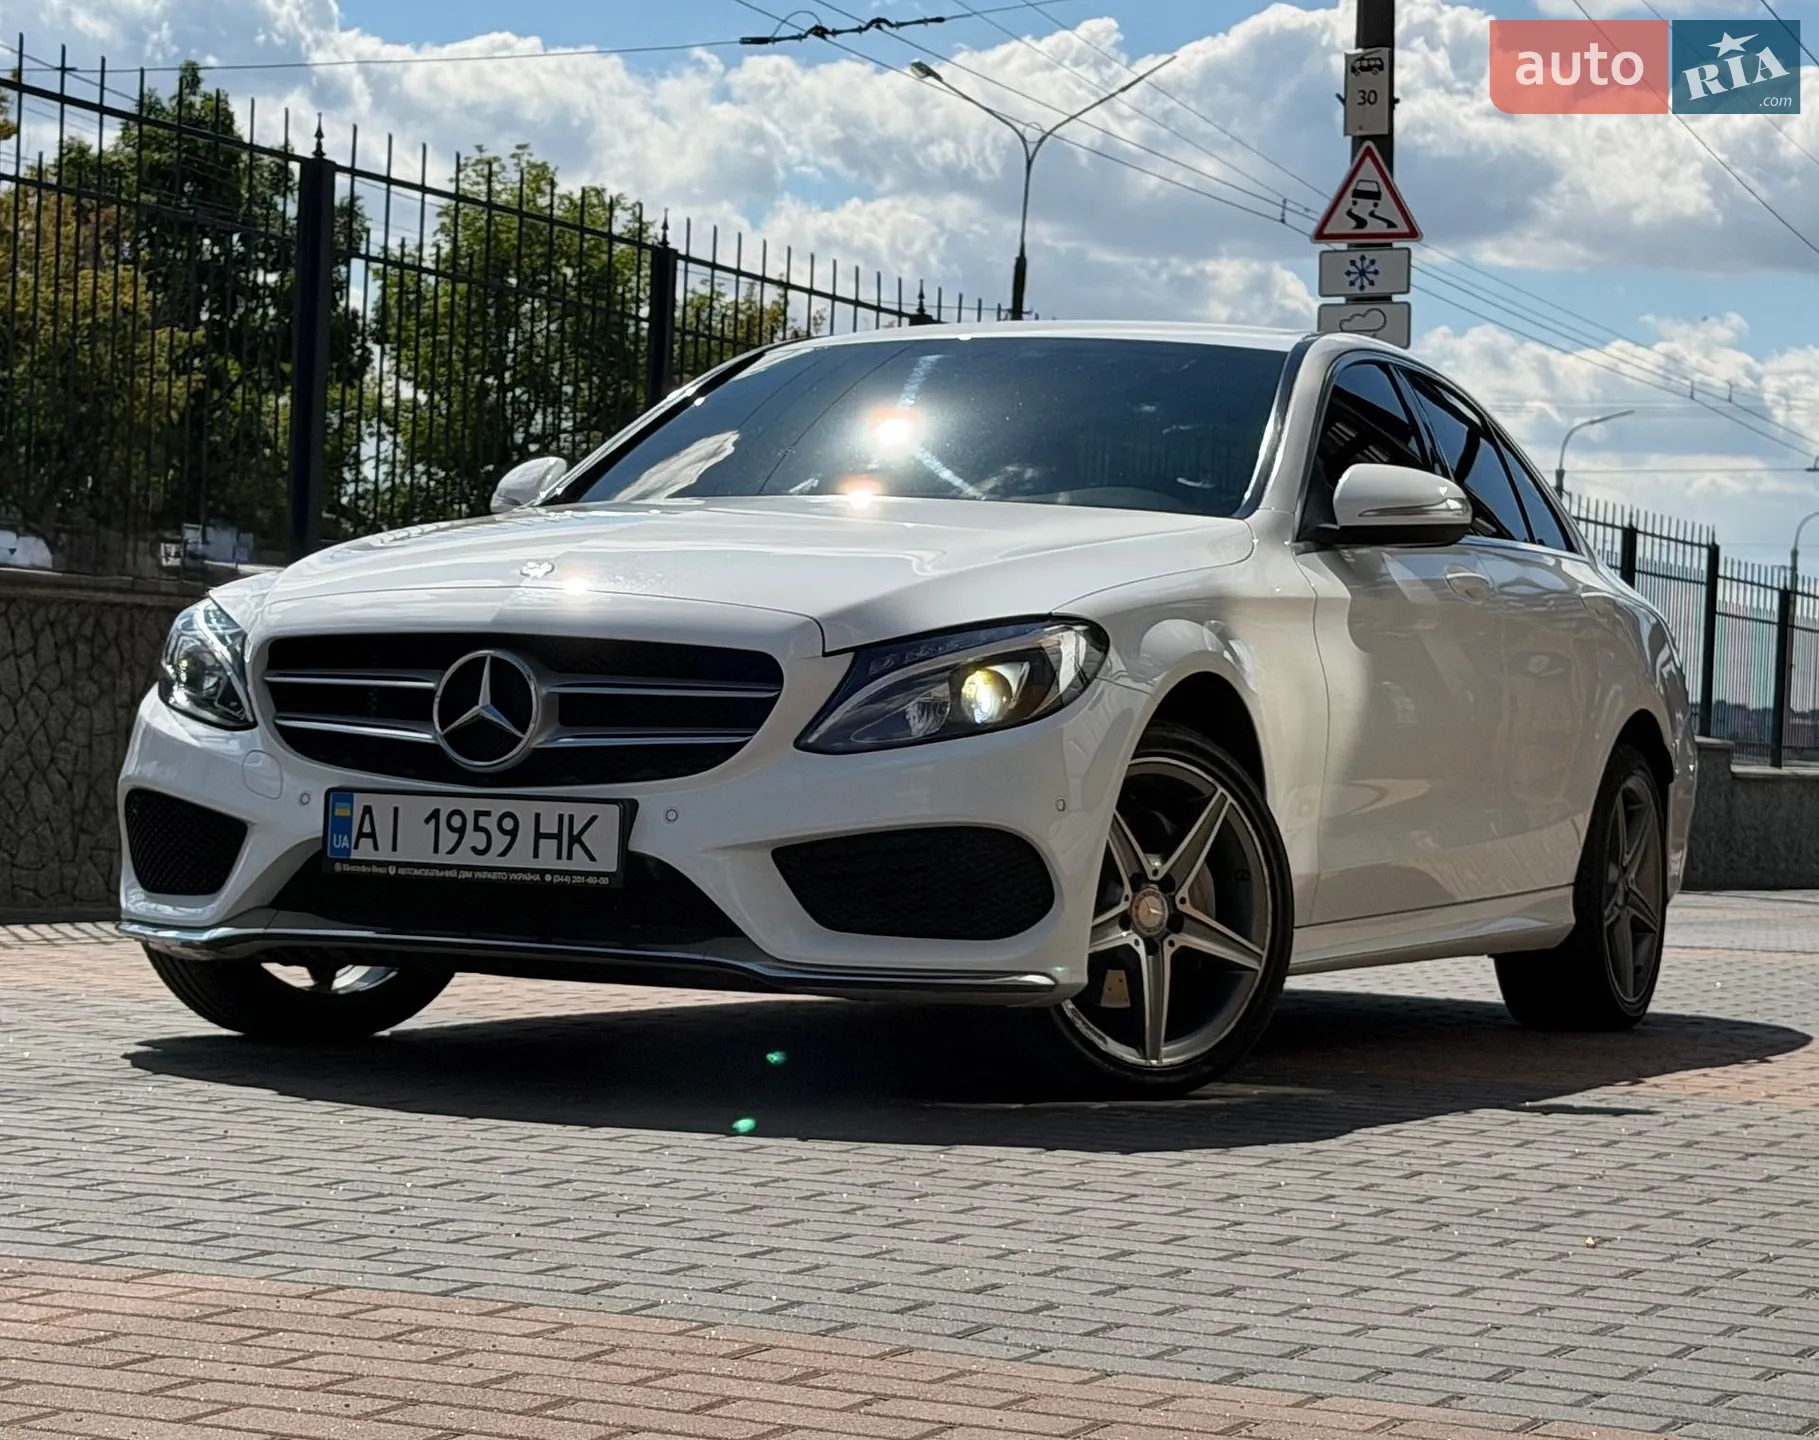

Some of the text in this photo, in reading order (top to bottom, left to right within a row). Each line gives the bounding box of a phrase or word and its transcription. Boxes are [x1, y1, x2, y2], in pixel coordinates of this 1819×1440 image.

[1356, 89, 1379, 107] 30
[332, 832, 350, 849] UA
[353, 804, 599, 862] AI 1959 HK
